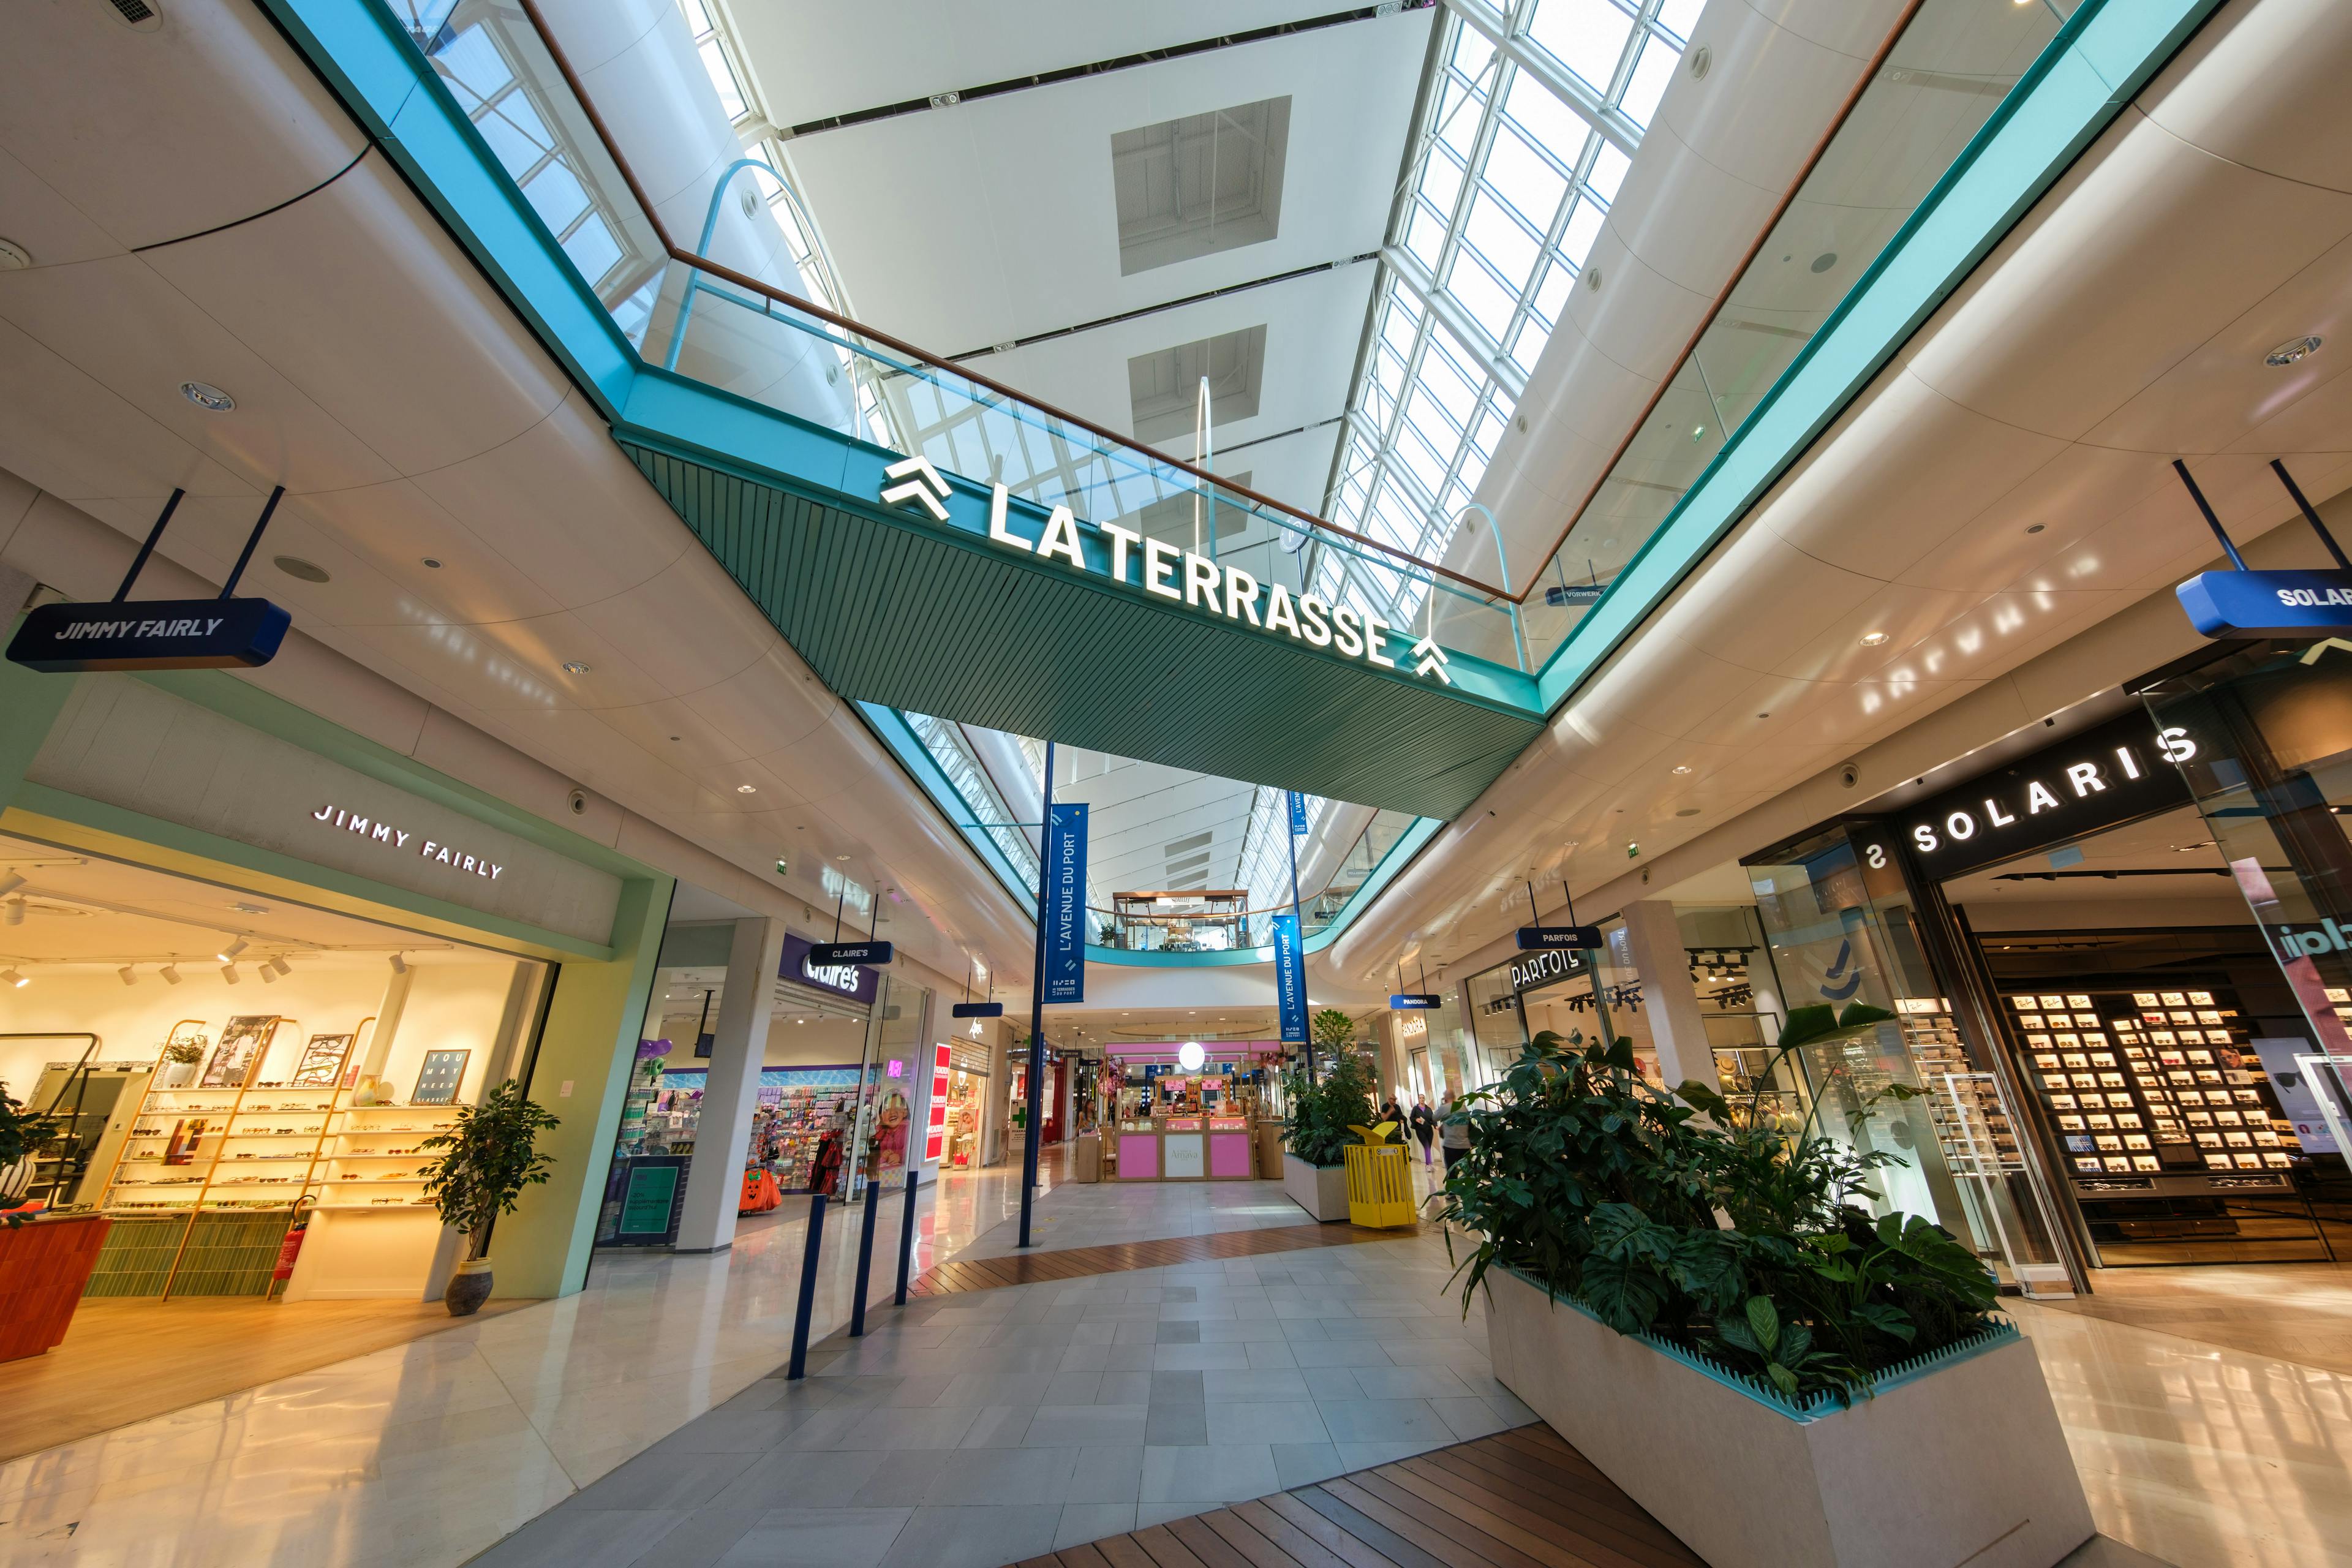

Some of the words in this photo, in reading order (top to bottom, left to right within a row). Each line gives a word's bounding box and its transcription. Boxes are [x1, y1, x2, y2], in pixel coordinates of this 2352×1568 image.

[990, 482, 1086, 568] LA
[1101, 521, 1395, 668] TERRASSE
[55, 621, 137, 639] JIMMY
[134, 619, 224, 638] FAIRLY
[1914, 727, 2196, 852] SOLARIS
[312, 805, 409, 847] JIMMY
[421, 841, 502, 880] FAIRLY
[1063, 832, 1075, 864] PORT
[1063, 867, 1074, 884] DU
[1060, 886, 1073, 951] L'AVENUE
[1281, 933, 1291, 954] PORT
[1283, 956, 1291, 967] DU
[1512, 950, 1578, 987] PARFOIS
[1285, 969, 1294, 1010] L'AVENUE
[432, 1054, 462, 1062] YOU
